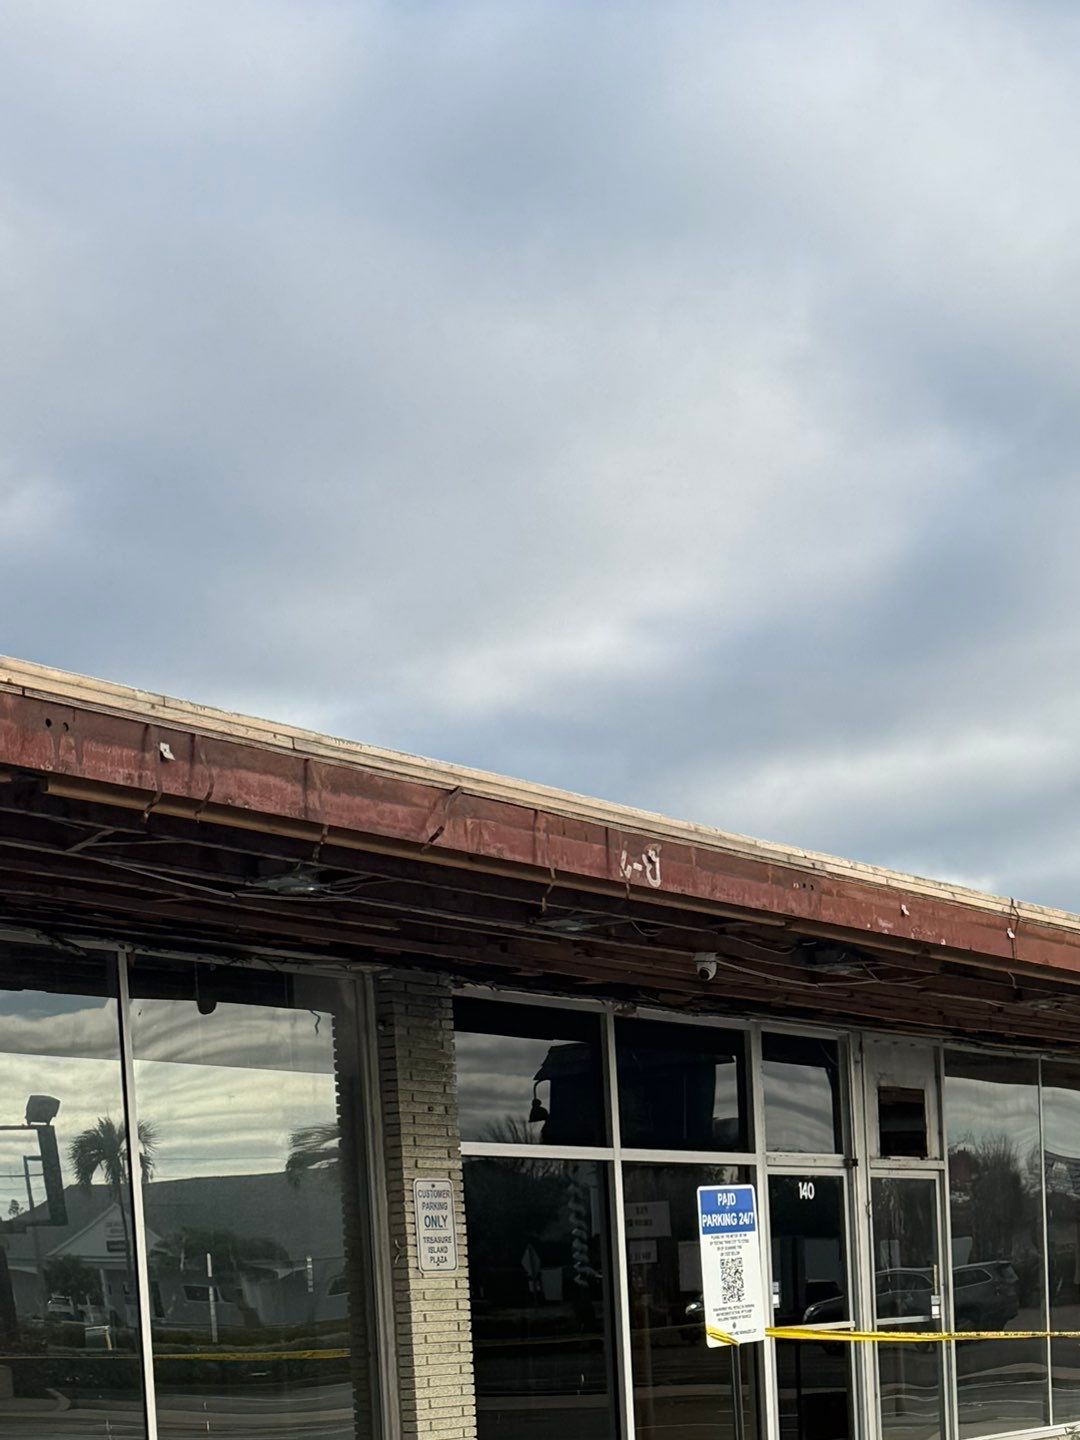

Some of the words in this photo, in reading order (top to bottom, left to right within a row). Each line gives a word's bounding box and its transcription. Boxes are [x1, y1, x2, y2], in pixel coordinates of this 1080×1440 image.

[418, 1190, 450, 1198] CUSTOMER
[799, 1182, 814, 1199] 140
[717, 1192, 736, 1206] PAID
[422, 1202, 448, 1211] PARKING
[424, 1215, 448, 1228] ONLY
[702, 1213, 737, 1227] PARKING
[738, 1212, 754, 1226] 24/7
[428, 1246, 448, 1254] ISLAND
[430, 1256, 448, 1264] PLAZA
